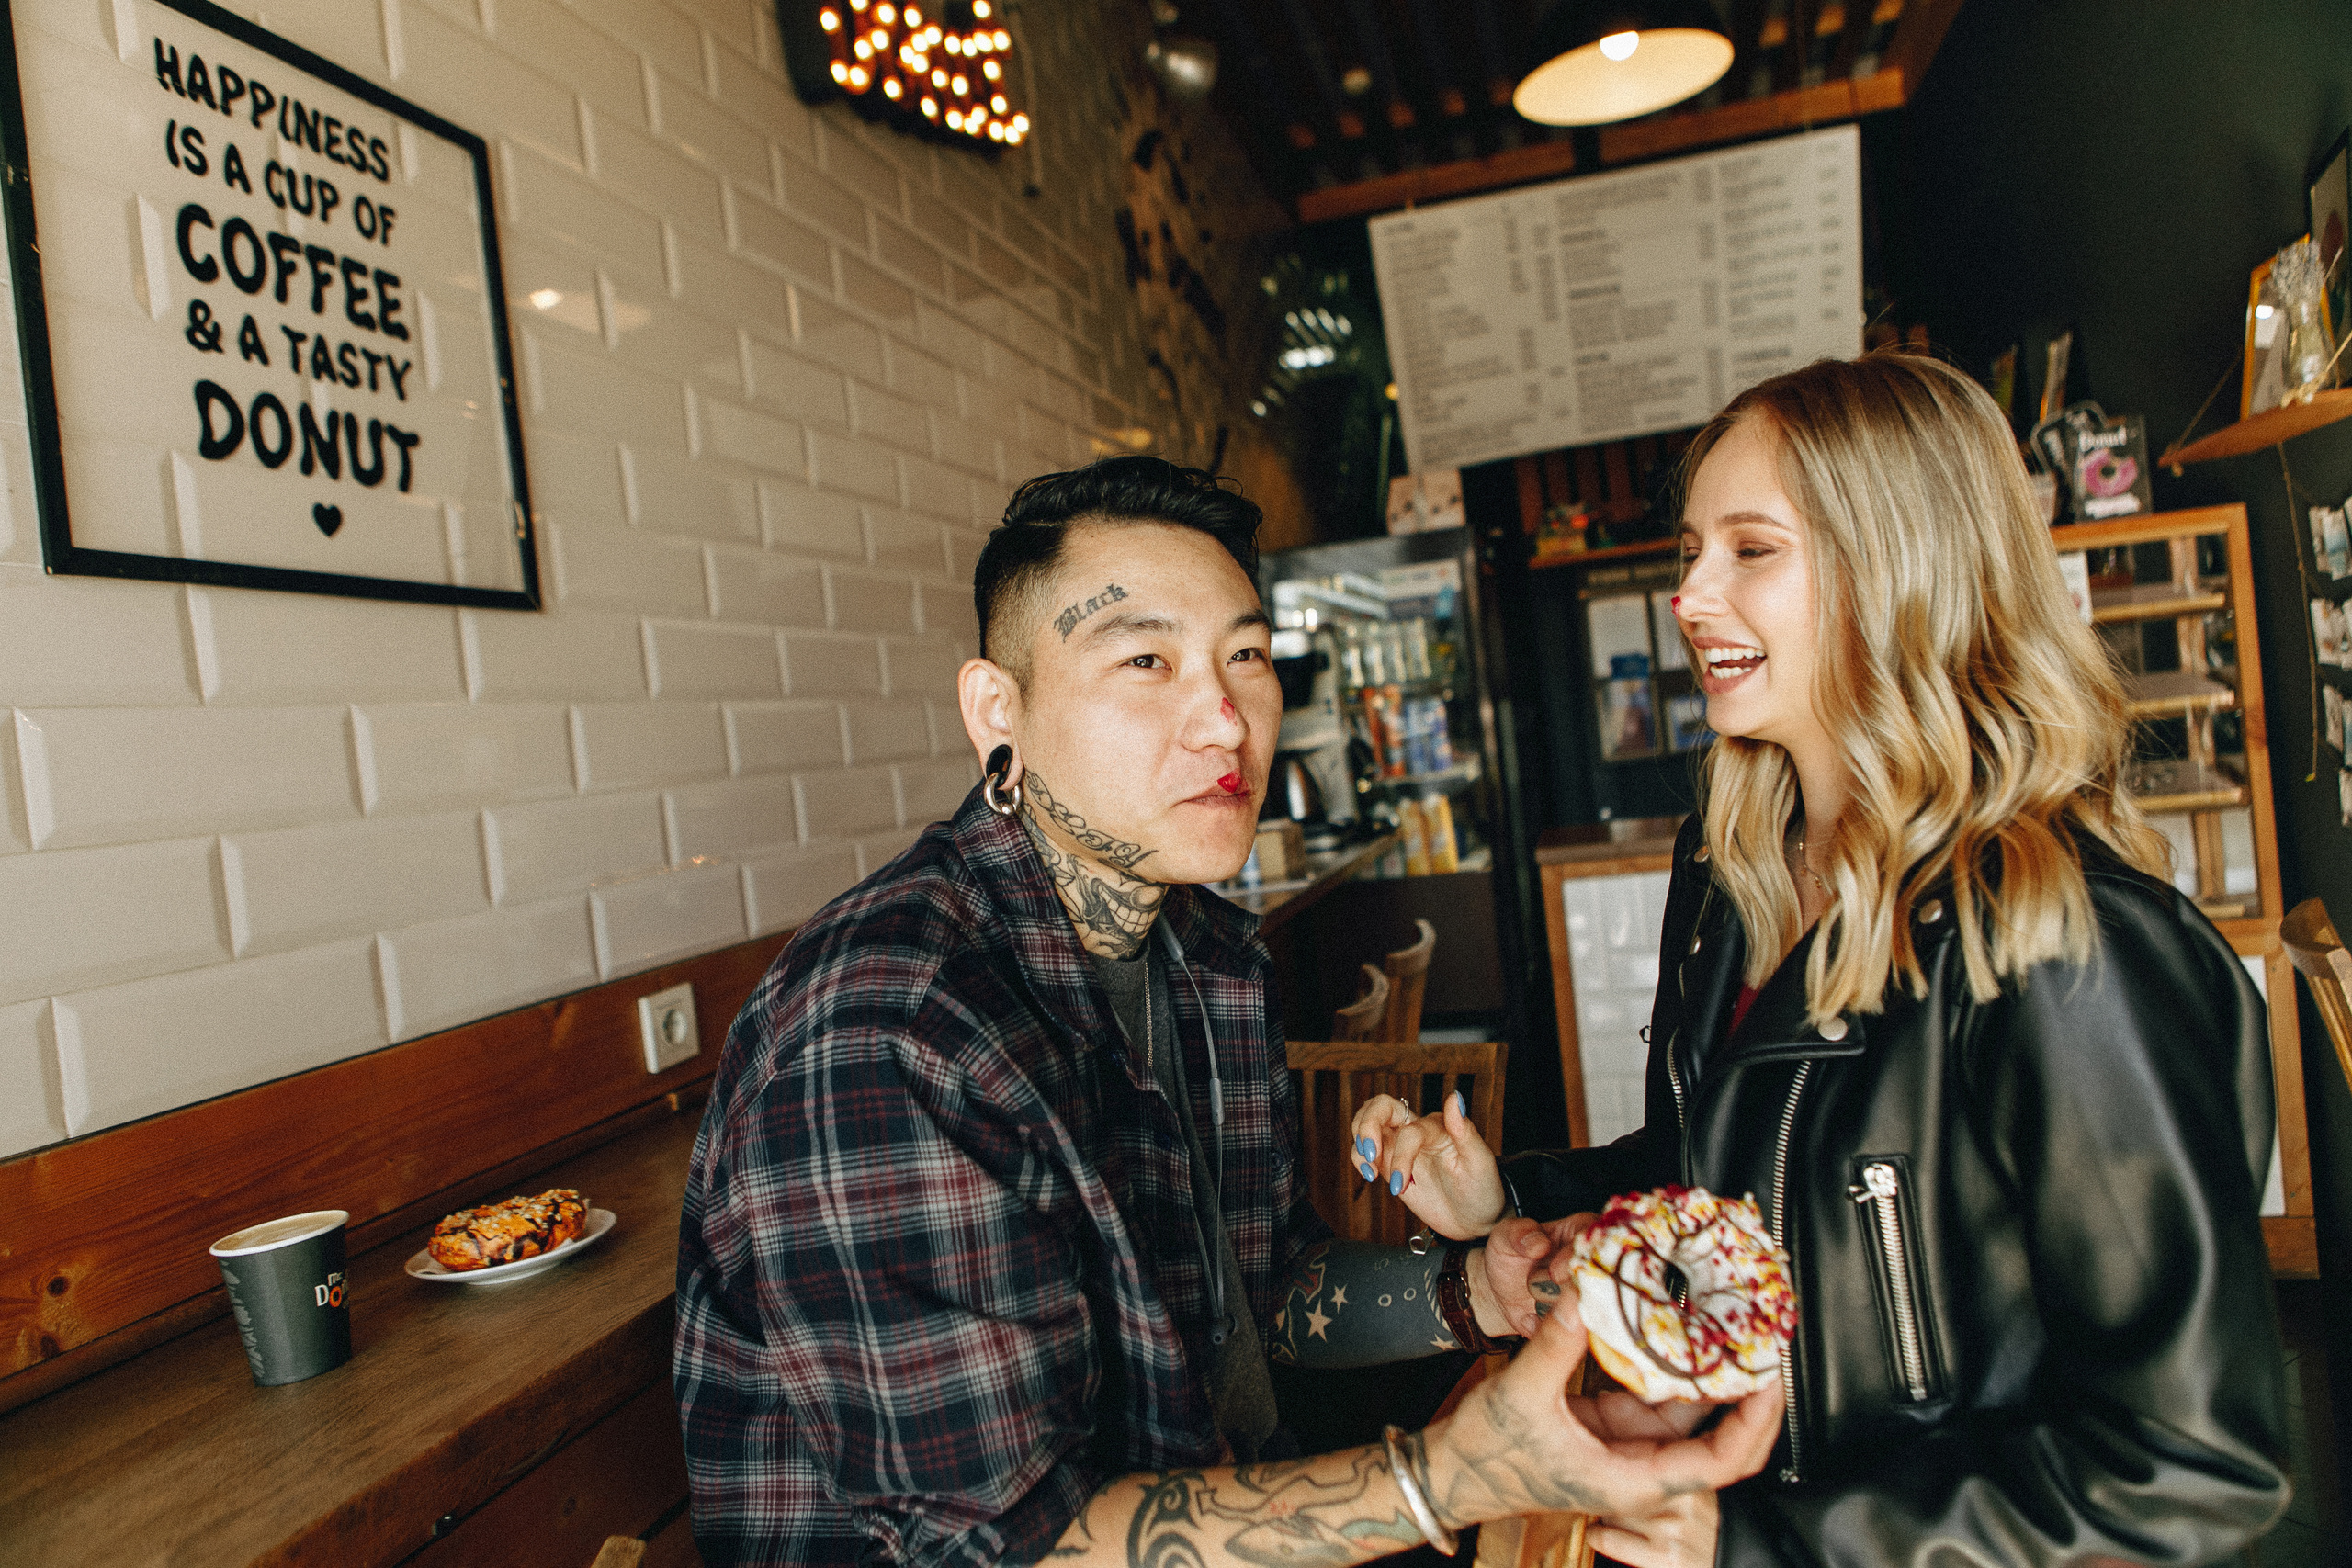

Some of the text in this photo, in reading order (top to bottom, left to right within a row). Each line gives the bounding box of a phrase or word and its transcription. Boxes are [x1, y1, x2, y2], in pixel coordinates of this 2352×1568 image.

[154, 37, 390, 182] HAPPINESS
[166, 119, 395, 245] IS A CUP OF
[176, 204, 410, 341] COFFEE
[186, 299, 411, 400] & A TASTY
[194, 379, 420, 492] DONUT
